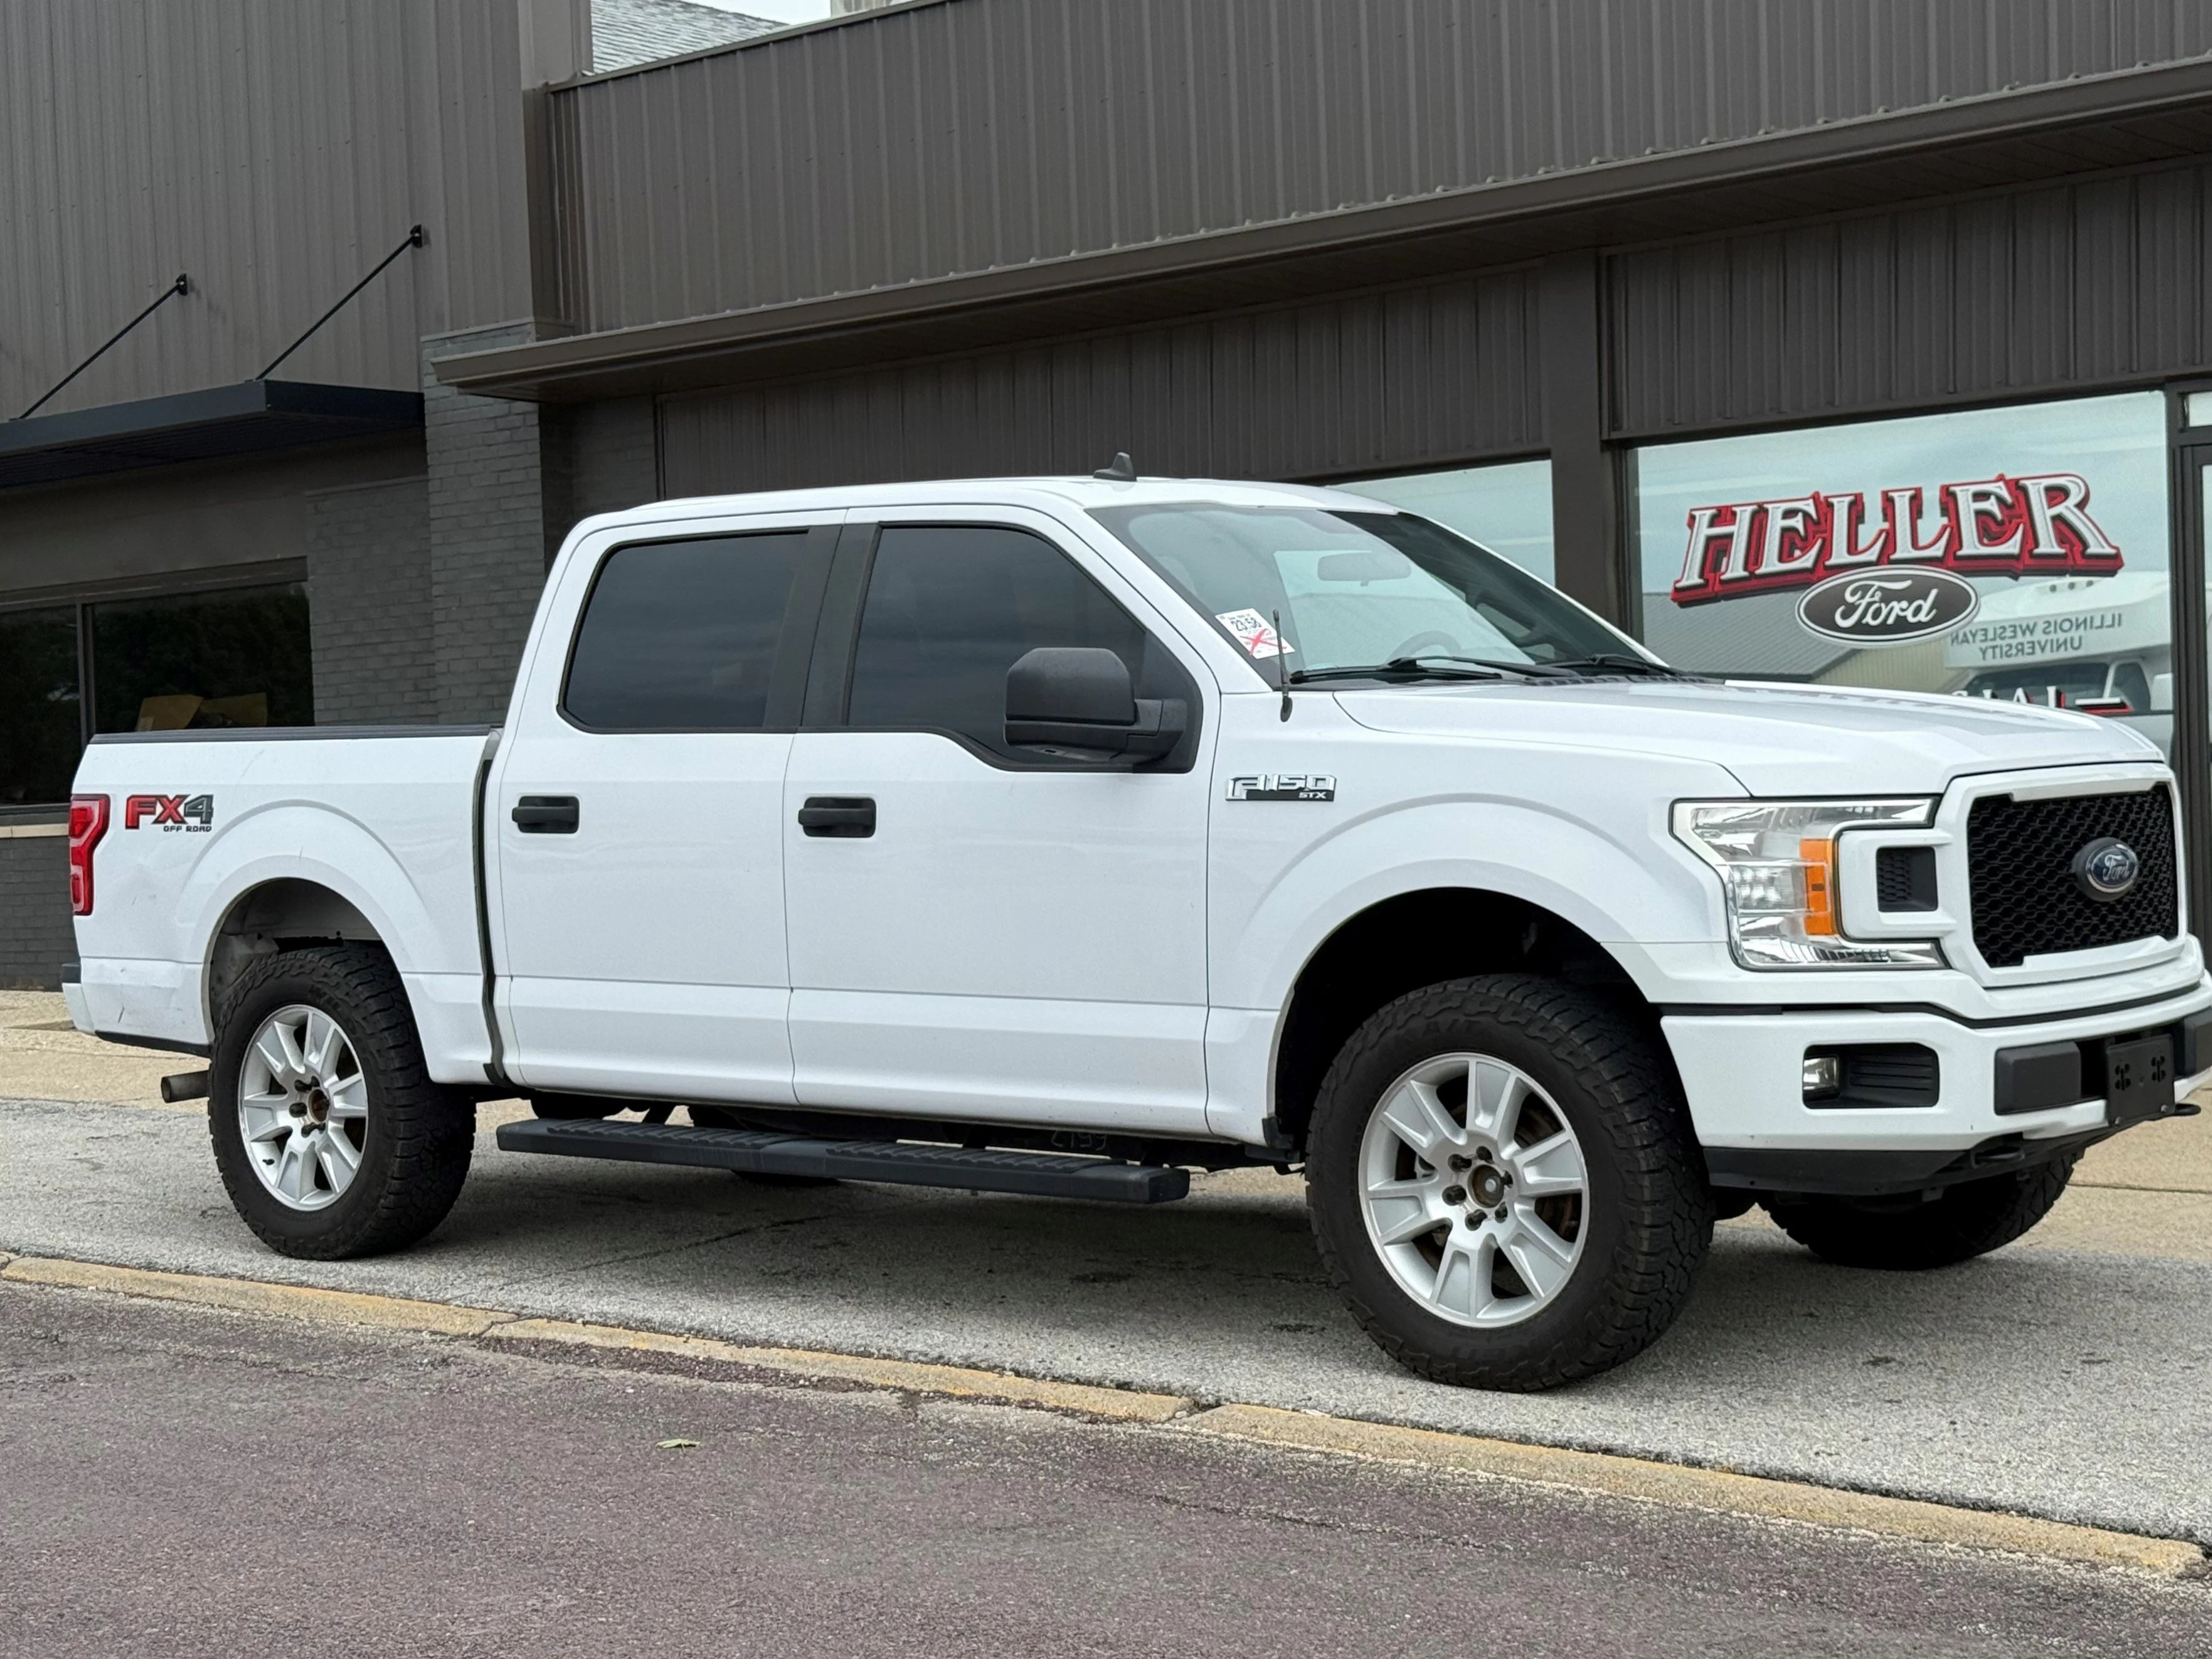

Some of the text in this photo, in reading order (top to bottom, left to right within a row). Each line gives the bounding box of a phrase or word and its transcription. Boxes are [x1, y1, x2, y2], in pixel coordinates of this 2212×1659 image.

[1673, 474, 2122, 591] HELLER
[1835, 580, 1938, 628] Ford
[125, 794, 214, 830] FX4
